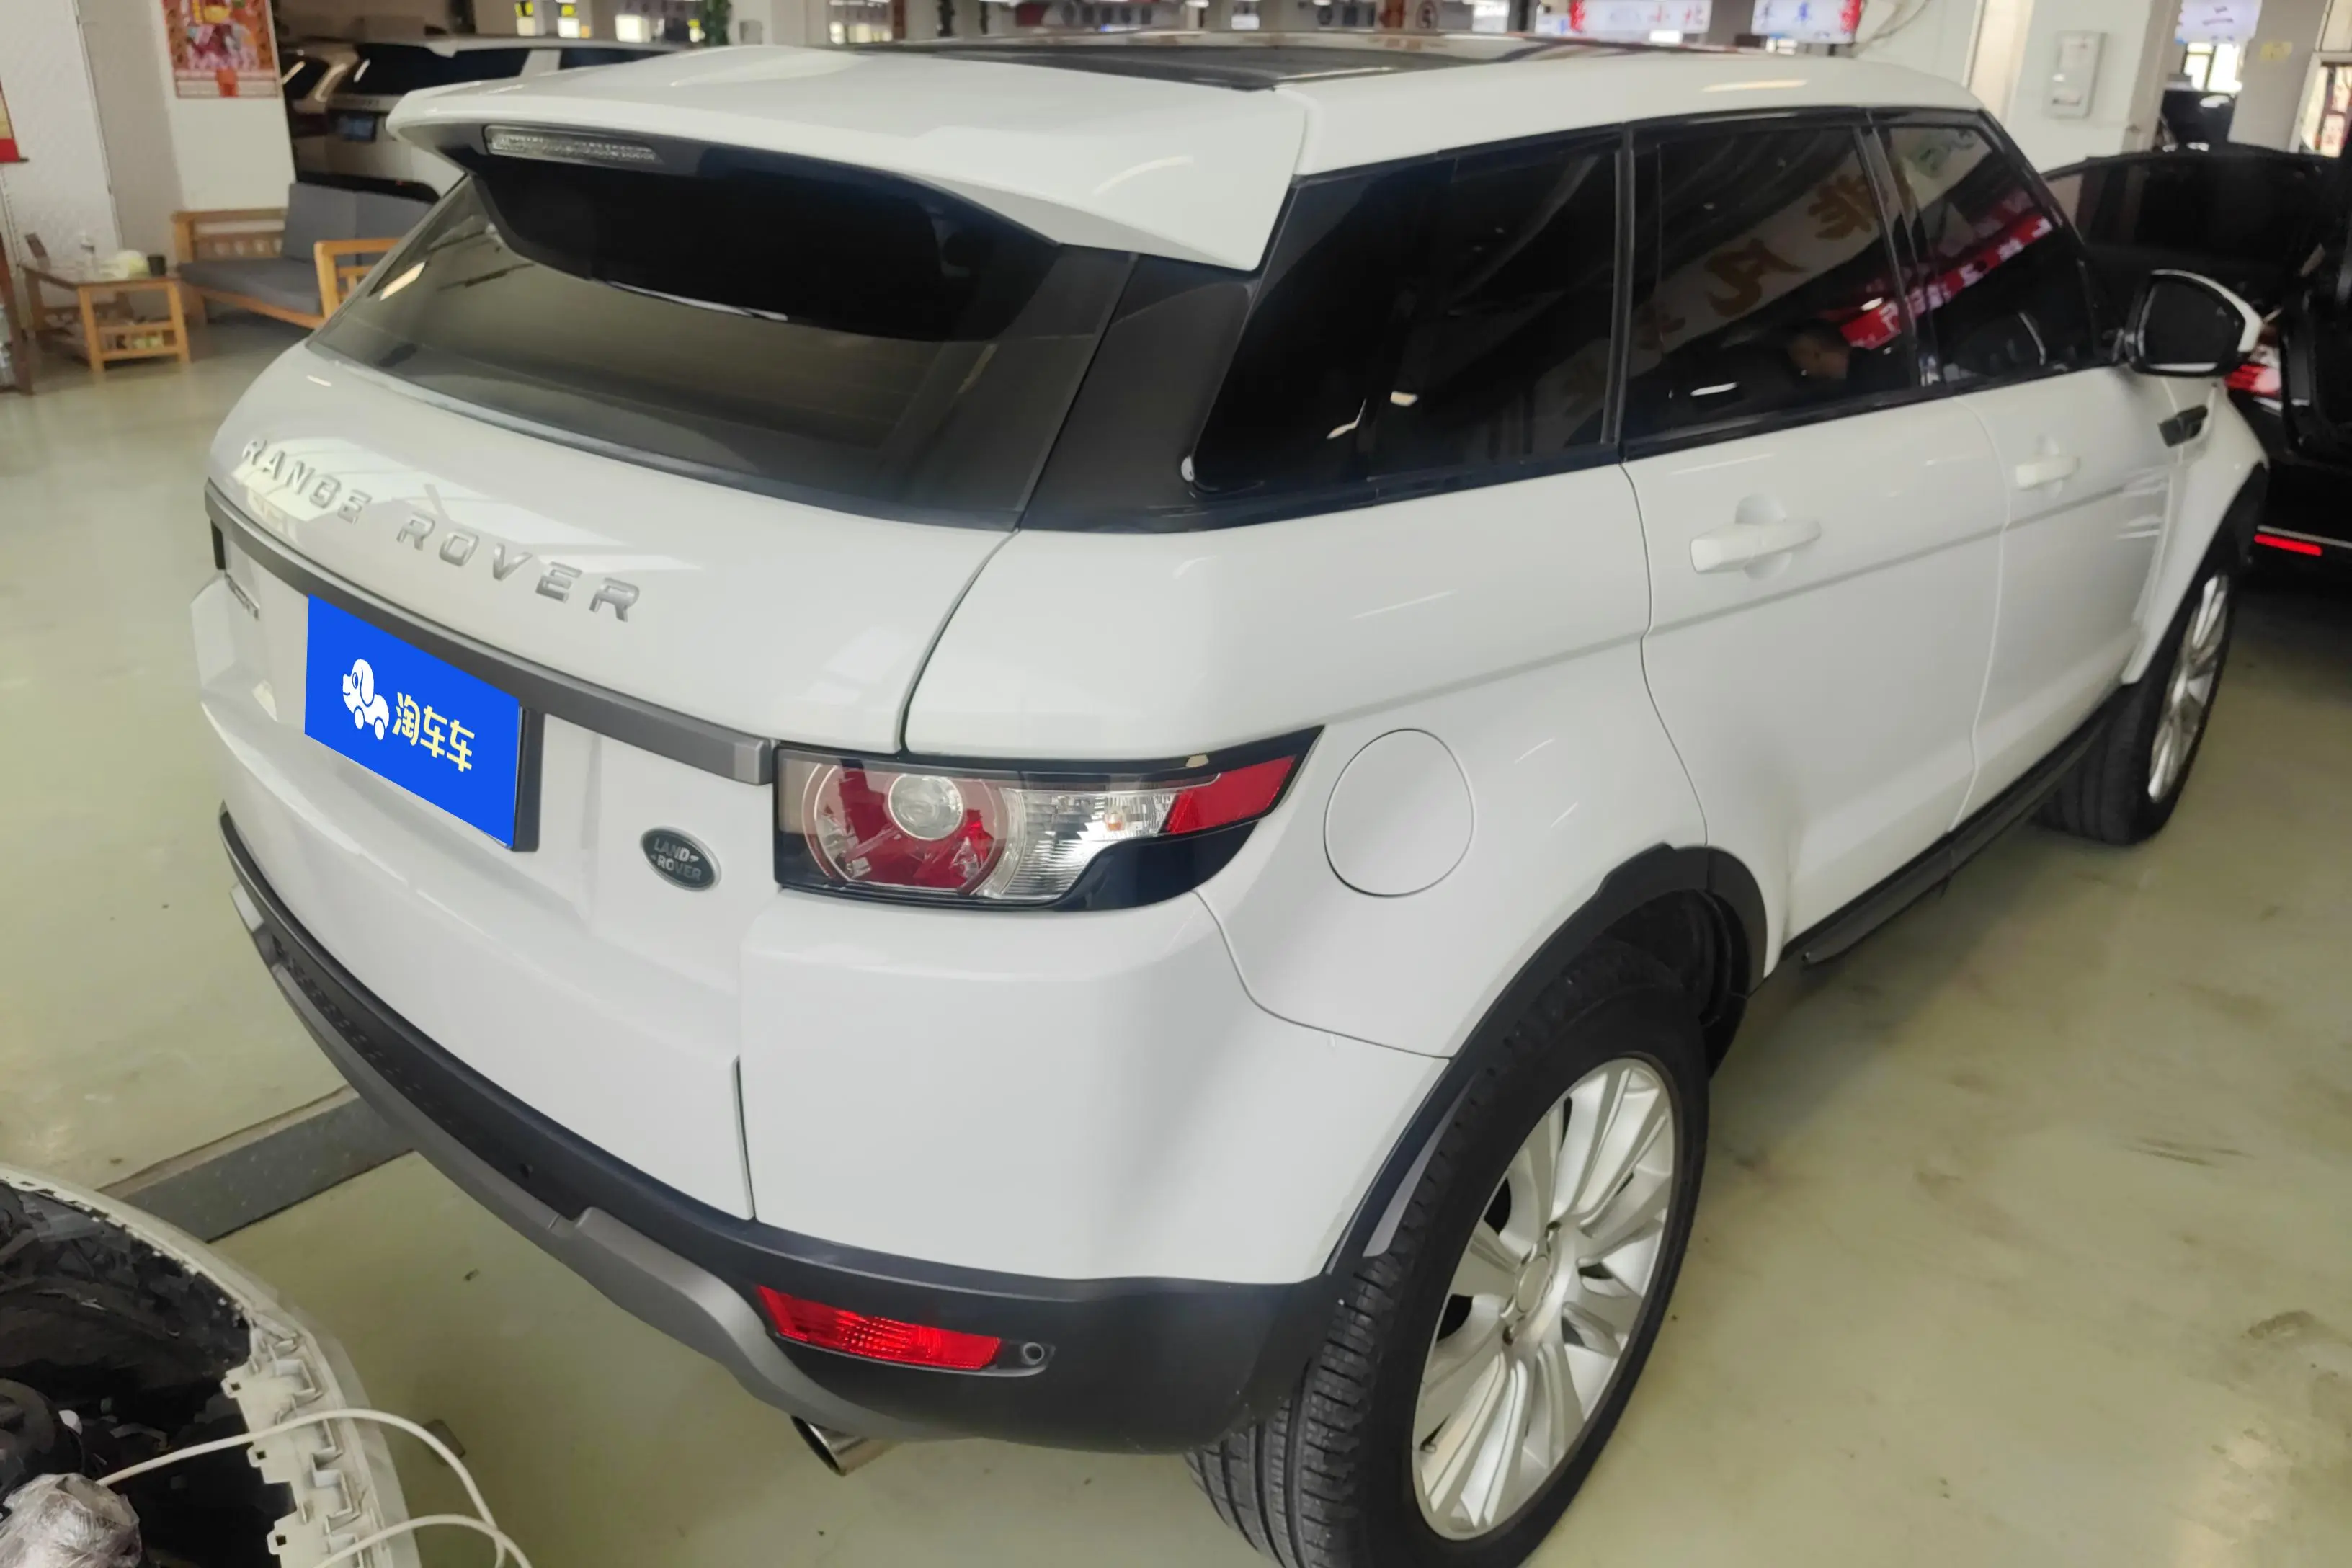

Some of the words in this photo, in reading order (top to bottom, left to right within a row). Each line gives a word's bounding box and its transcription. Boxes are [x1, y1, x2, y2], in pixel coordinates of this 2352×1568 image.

[241, 439, 372, 524] RANGE
[396, 510, 640, 623] ROVER
[654, 837, 690, 862] LAND
[657, 855, 702, 881] ROVER
